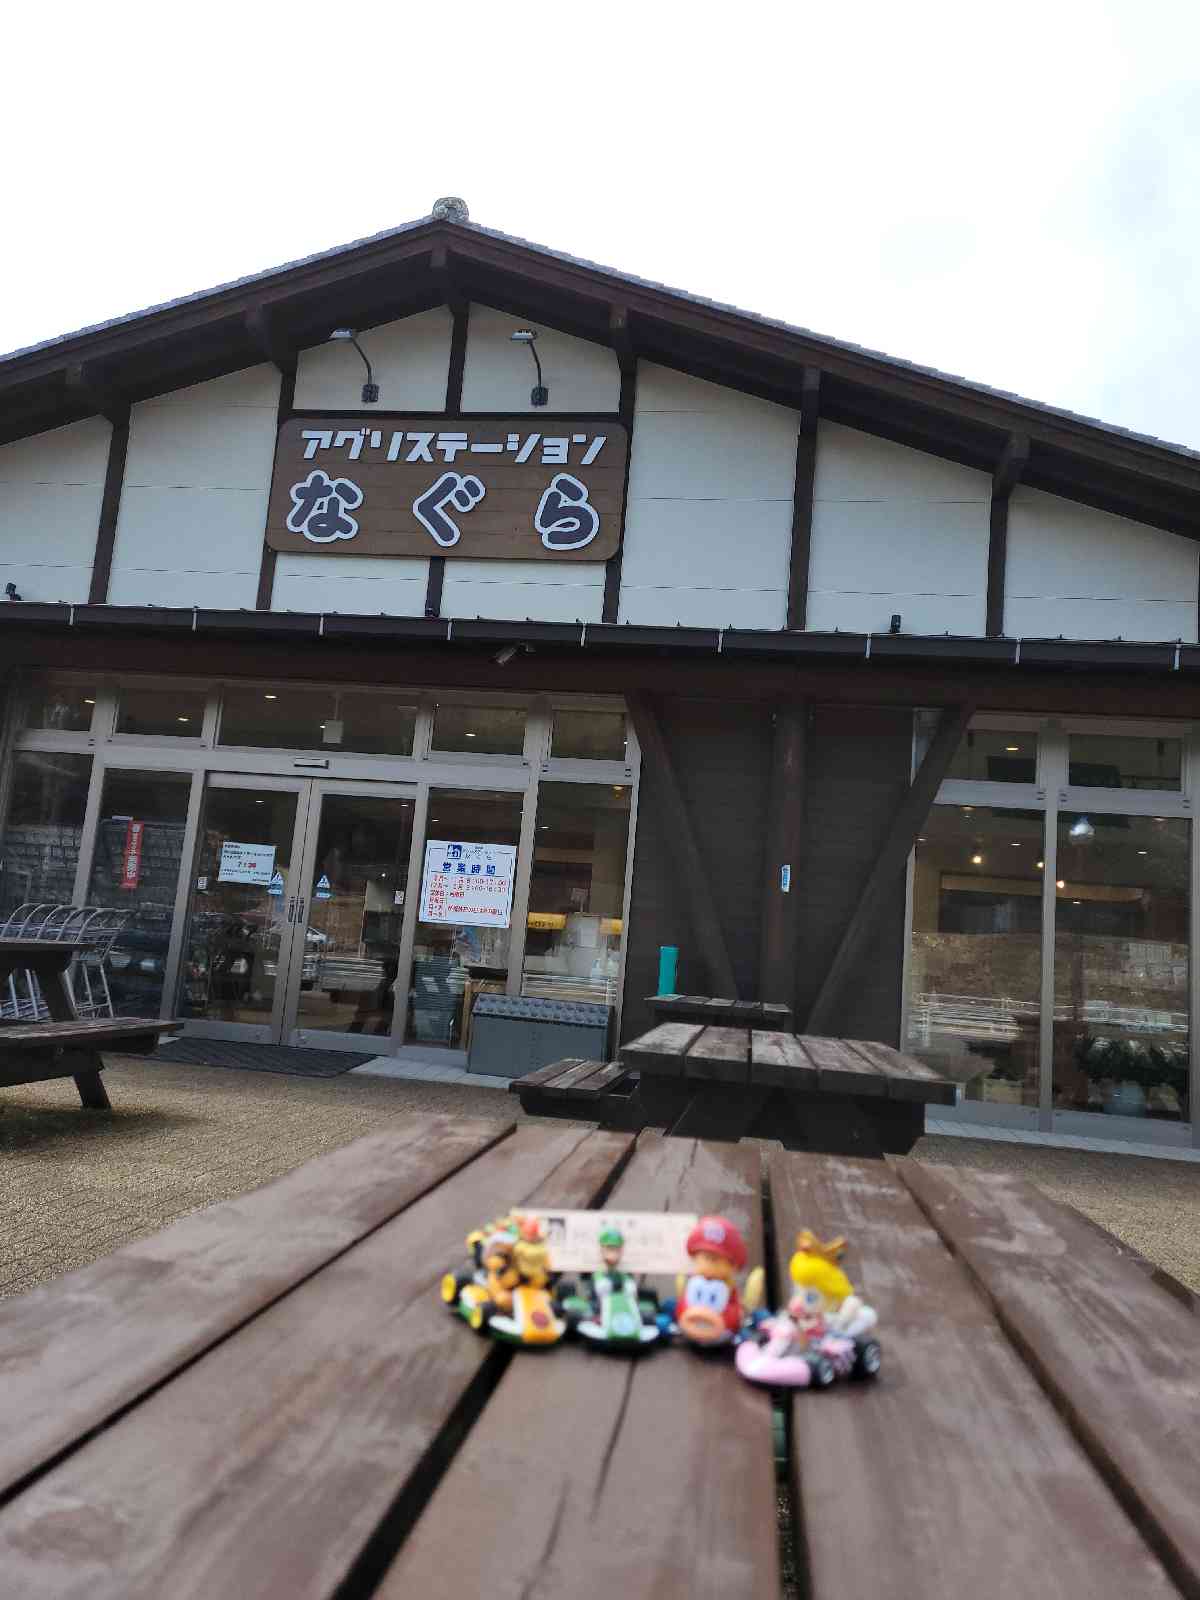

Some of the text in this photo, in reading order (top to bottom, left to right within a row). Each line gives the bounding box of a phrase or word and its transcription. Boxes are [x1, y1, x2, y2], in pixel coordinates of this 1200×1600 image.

[301, 427, 607, 465] アグリステーション
[286, 469, 600, 551] なぐら
